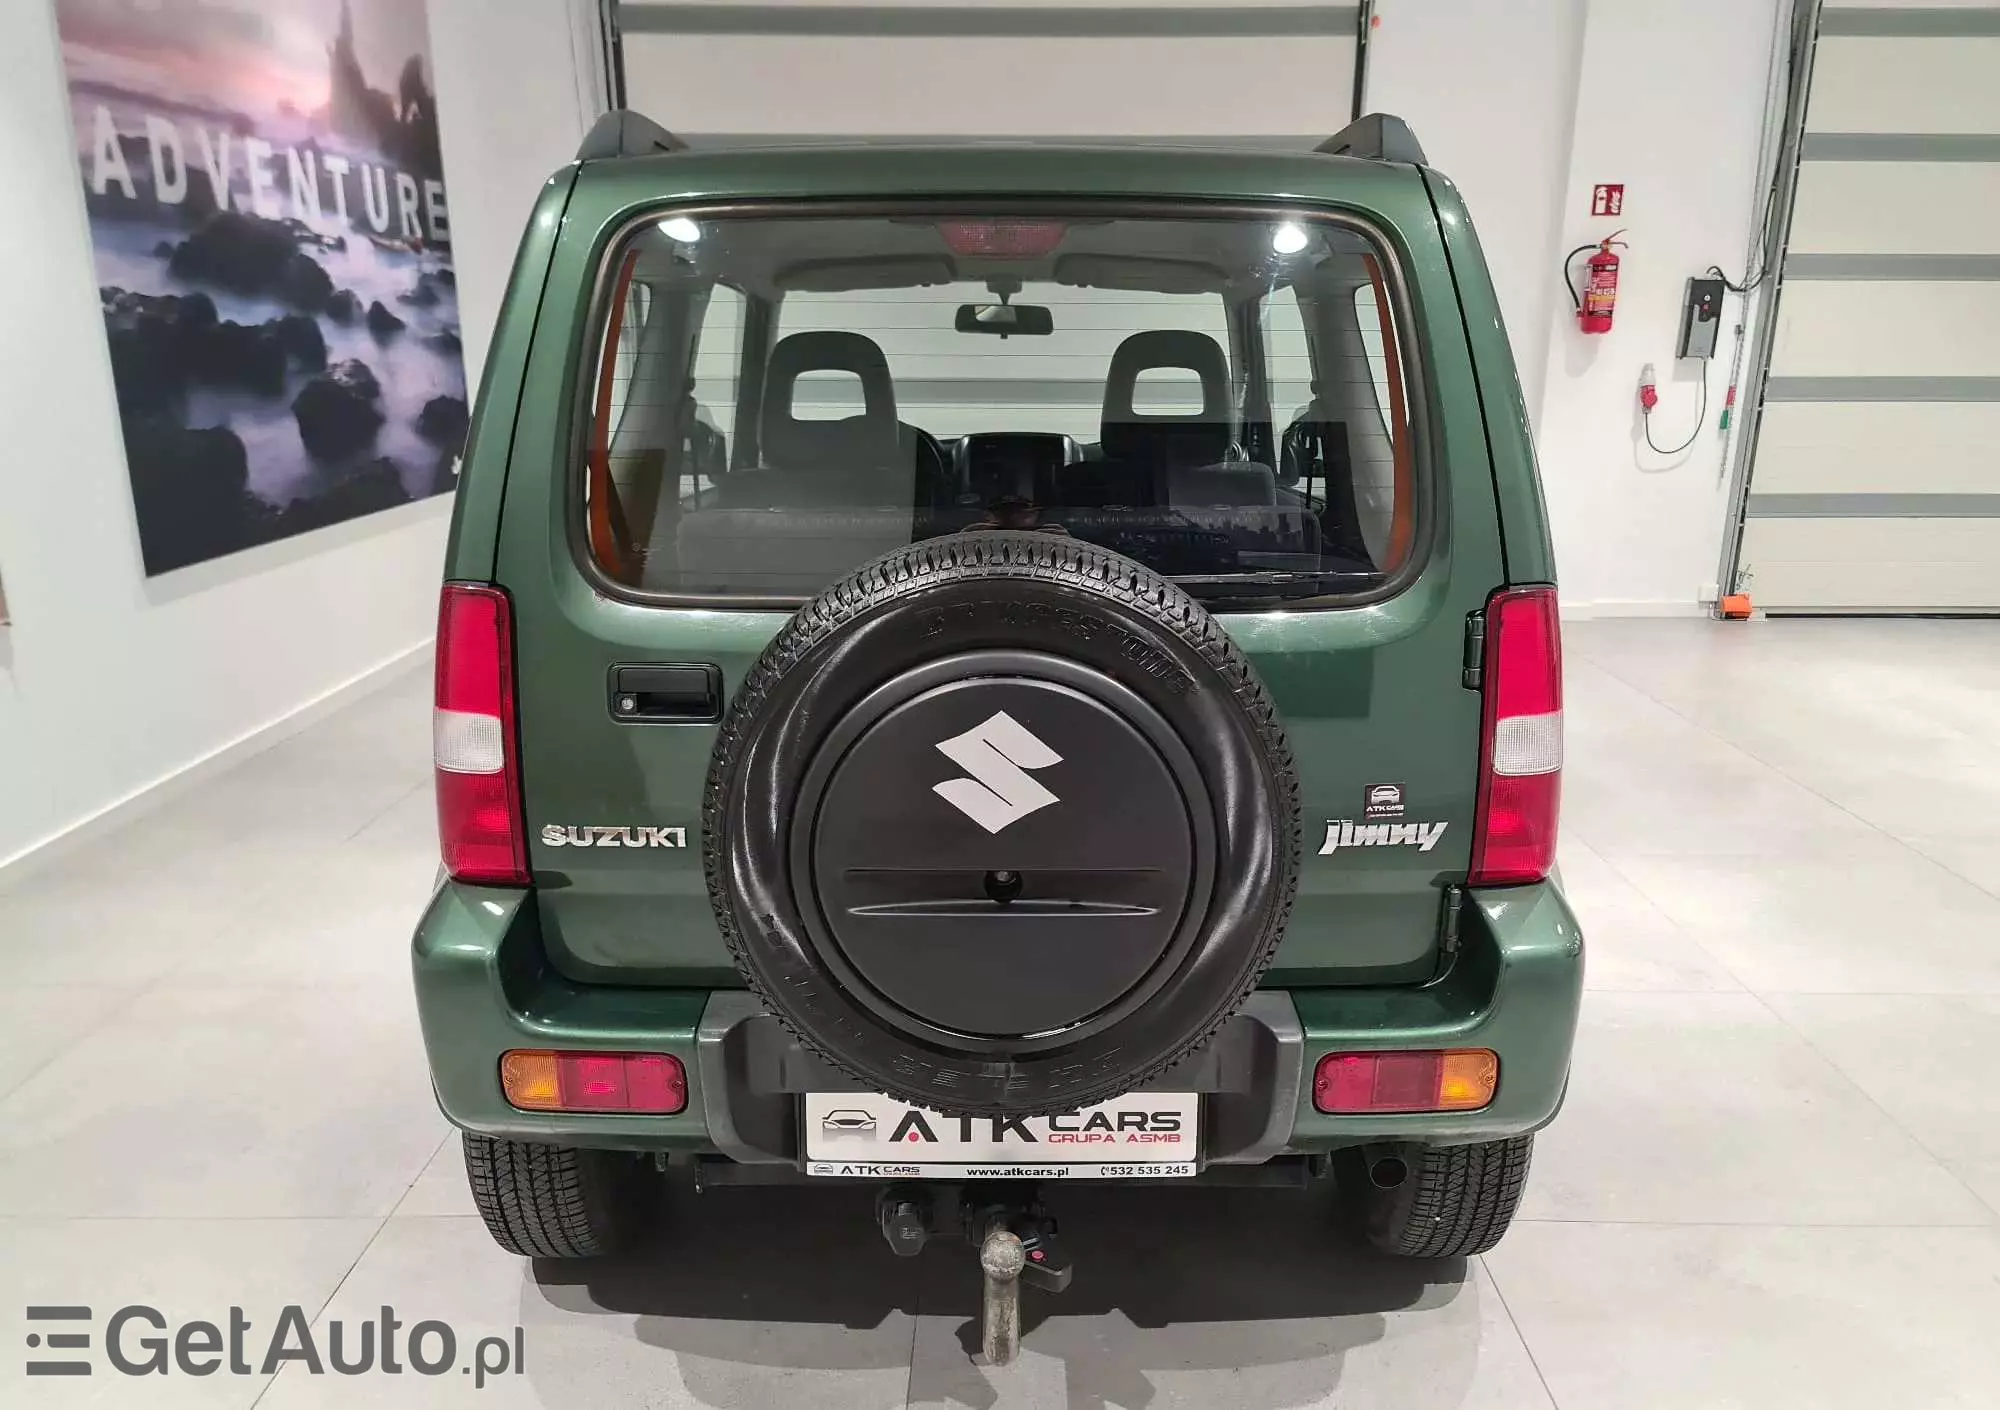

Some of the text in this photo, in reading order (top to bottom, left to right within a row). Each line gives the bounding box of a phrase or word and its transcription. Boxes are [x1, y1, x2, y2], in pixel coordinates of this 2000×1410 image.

[90, 105, 449, 242] ADVENTURE
[541, 824, 688, 849] SUZUKI
[889, 1110, 1182, 1143] ATK CARS
[1049, 1133, 1181, 1143] GRUPA ASMB
[840, 1165, 881, 1175] ATK
[883, 1166, 920, 1174] CARS
[967, 1167, 1069, 1178] www.atkcars.pl
[1110, 1165, 1188, 1176] 532 535 245
